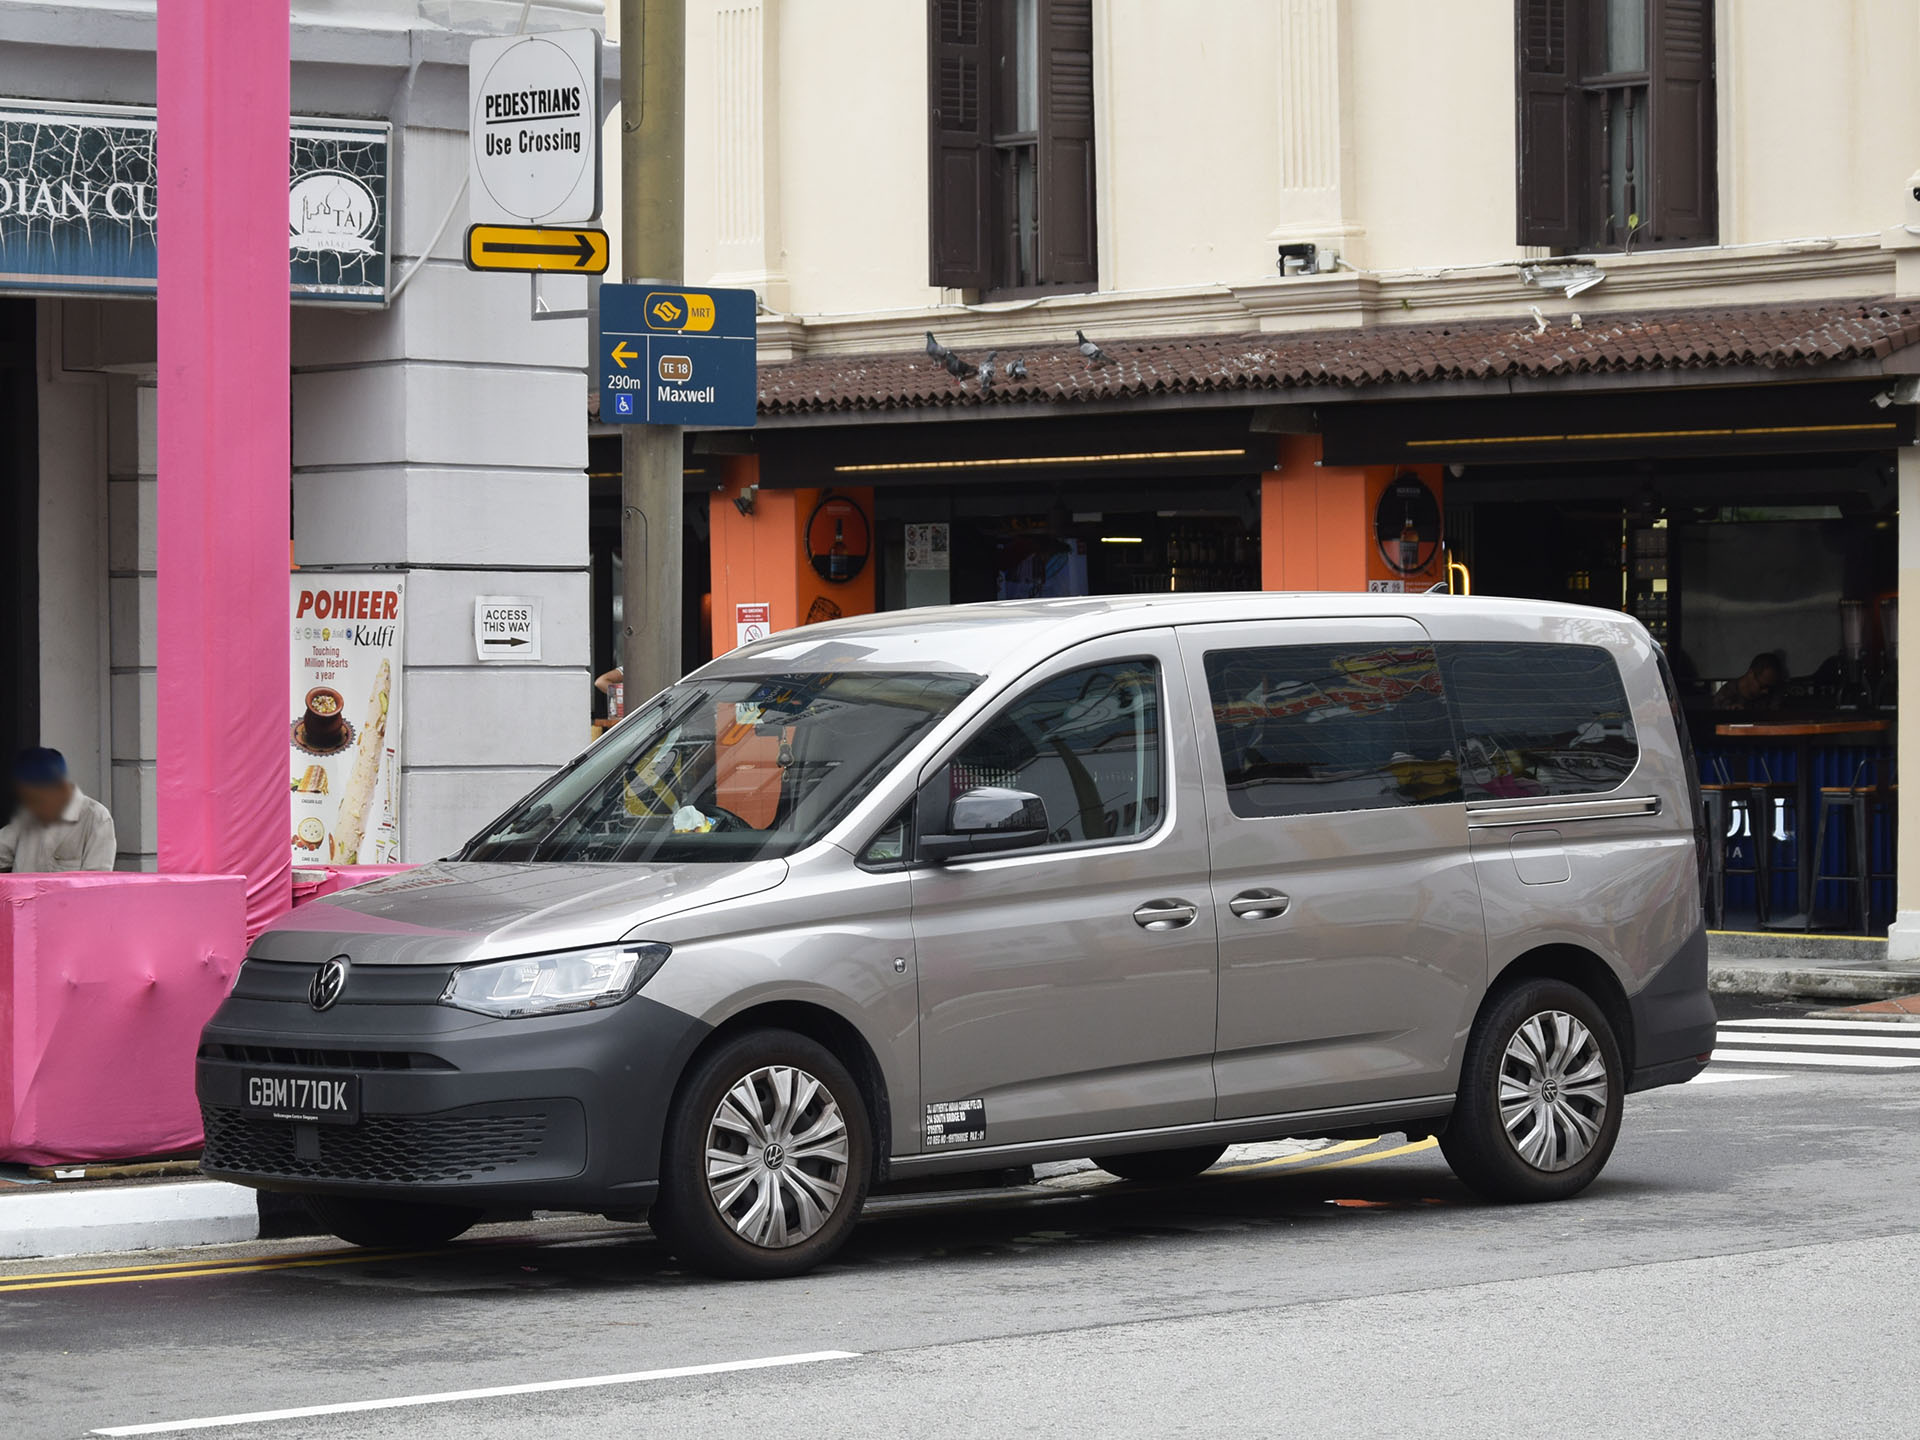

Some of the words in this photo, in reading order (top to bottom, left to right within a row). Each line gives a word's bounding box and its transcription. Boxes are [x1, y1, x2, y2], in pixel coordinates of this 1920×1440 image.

[485, 86, 580, 118] PEDESTRIANS
[486, 133, 511, 156] Use
[519, 128, 580, 153] Crossing
[691, 307, 711, 318] MRT
[663, 362, 674, 374] TE
[677, 363, 688, 374] 18
[608, 375, 641, 389] 290m
[657, 386, 714, 403] Maxwell
[296, 590, 398, 619] POHIEER
[485, 609, 528, 620] ACCESS
[483, 621, 506, 632] THIS
[508, 621, 531, 632] WAY
[354, 625, 396, 649] Kulfi
[312, 646, 340, 658] Touching
[304, 658, 325, 668] Million
[326, 658, 349, 668] Hearts
[315, 672, 319, 680] a
[321, 672, 335, 682] year
[249, 1077, 347, 1111] GBM1710K
